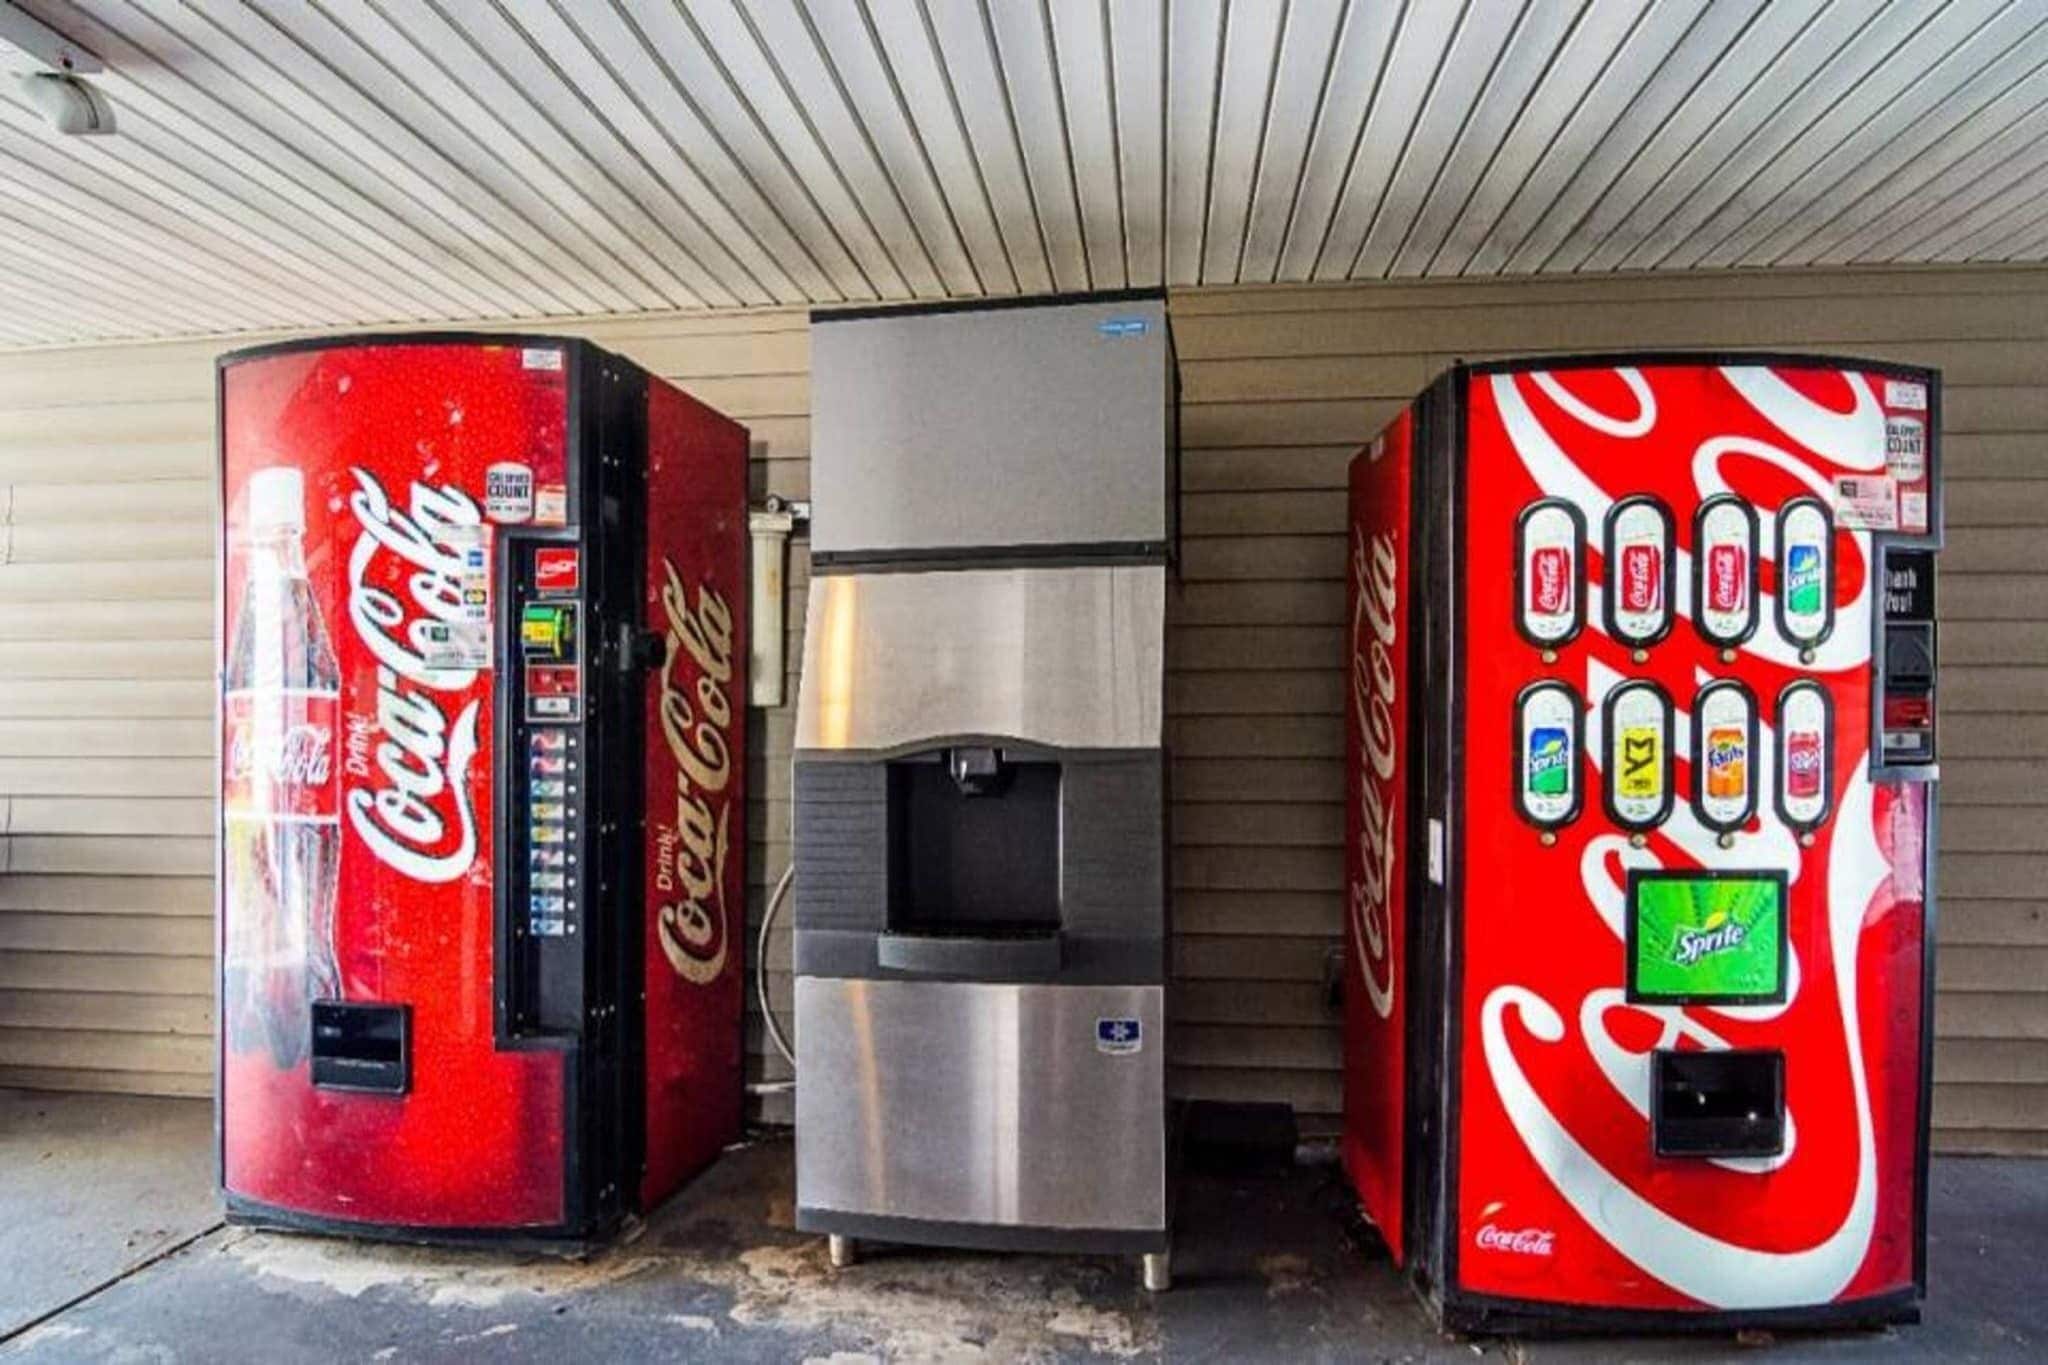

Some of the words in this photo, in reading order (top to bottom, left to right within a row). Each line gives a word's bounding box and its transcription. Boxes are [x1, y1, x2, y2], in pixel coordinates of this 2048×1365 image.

[1887, 438, 1921, 453] COUNT
[488, 485, 528, 498] COUNT
[1675, 923, 1744, 965] Sprite
[1476, 1224, 1555, 1255] Coca-Cola
